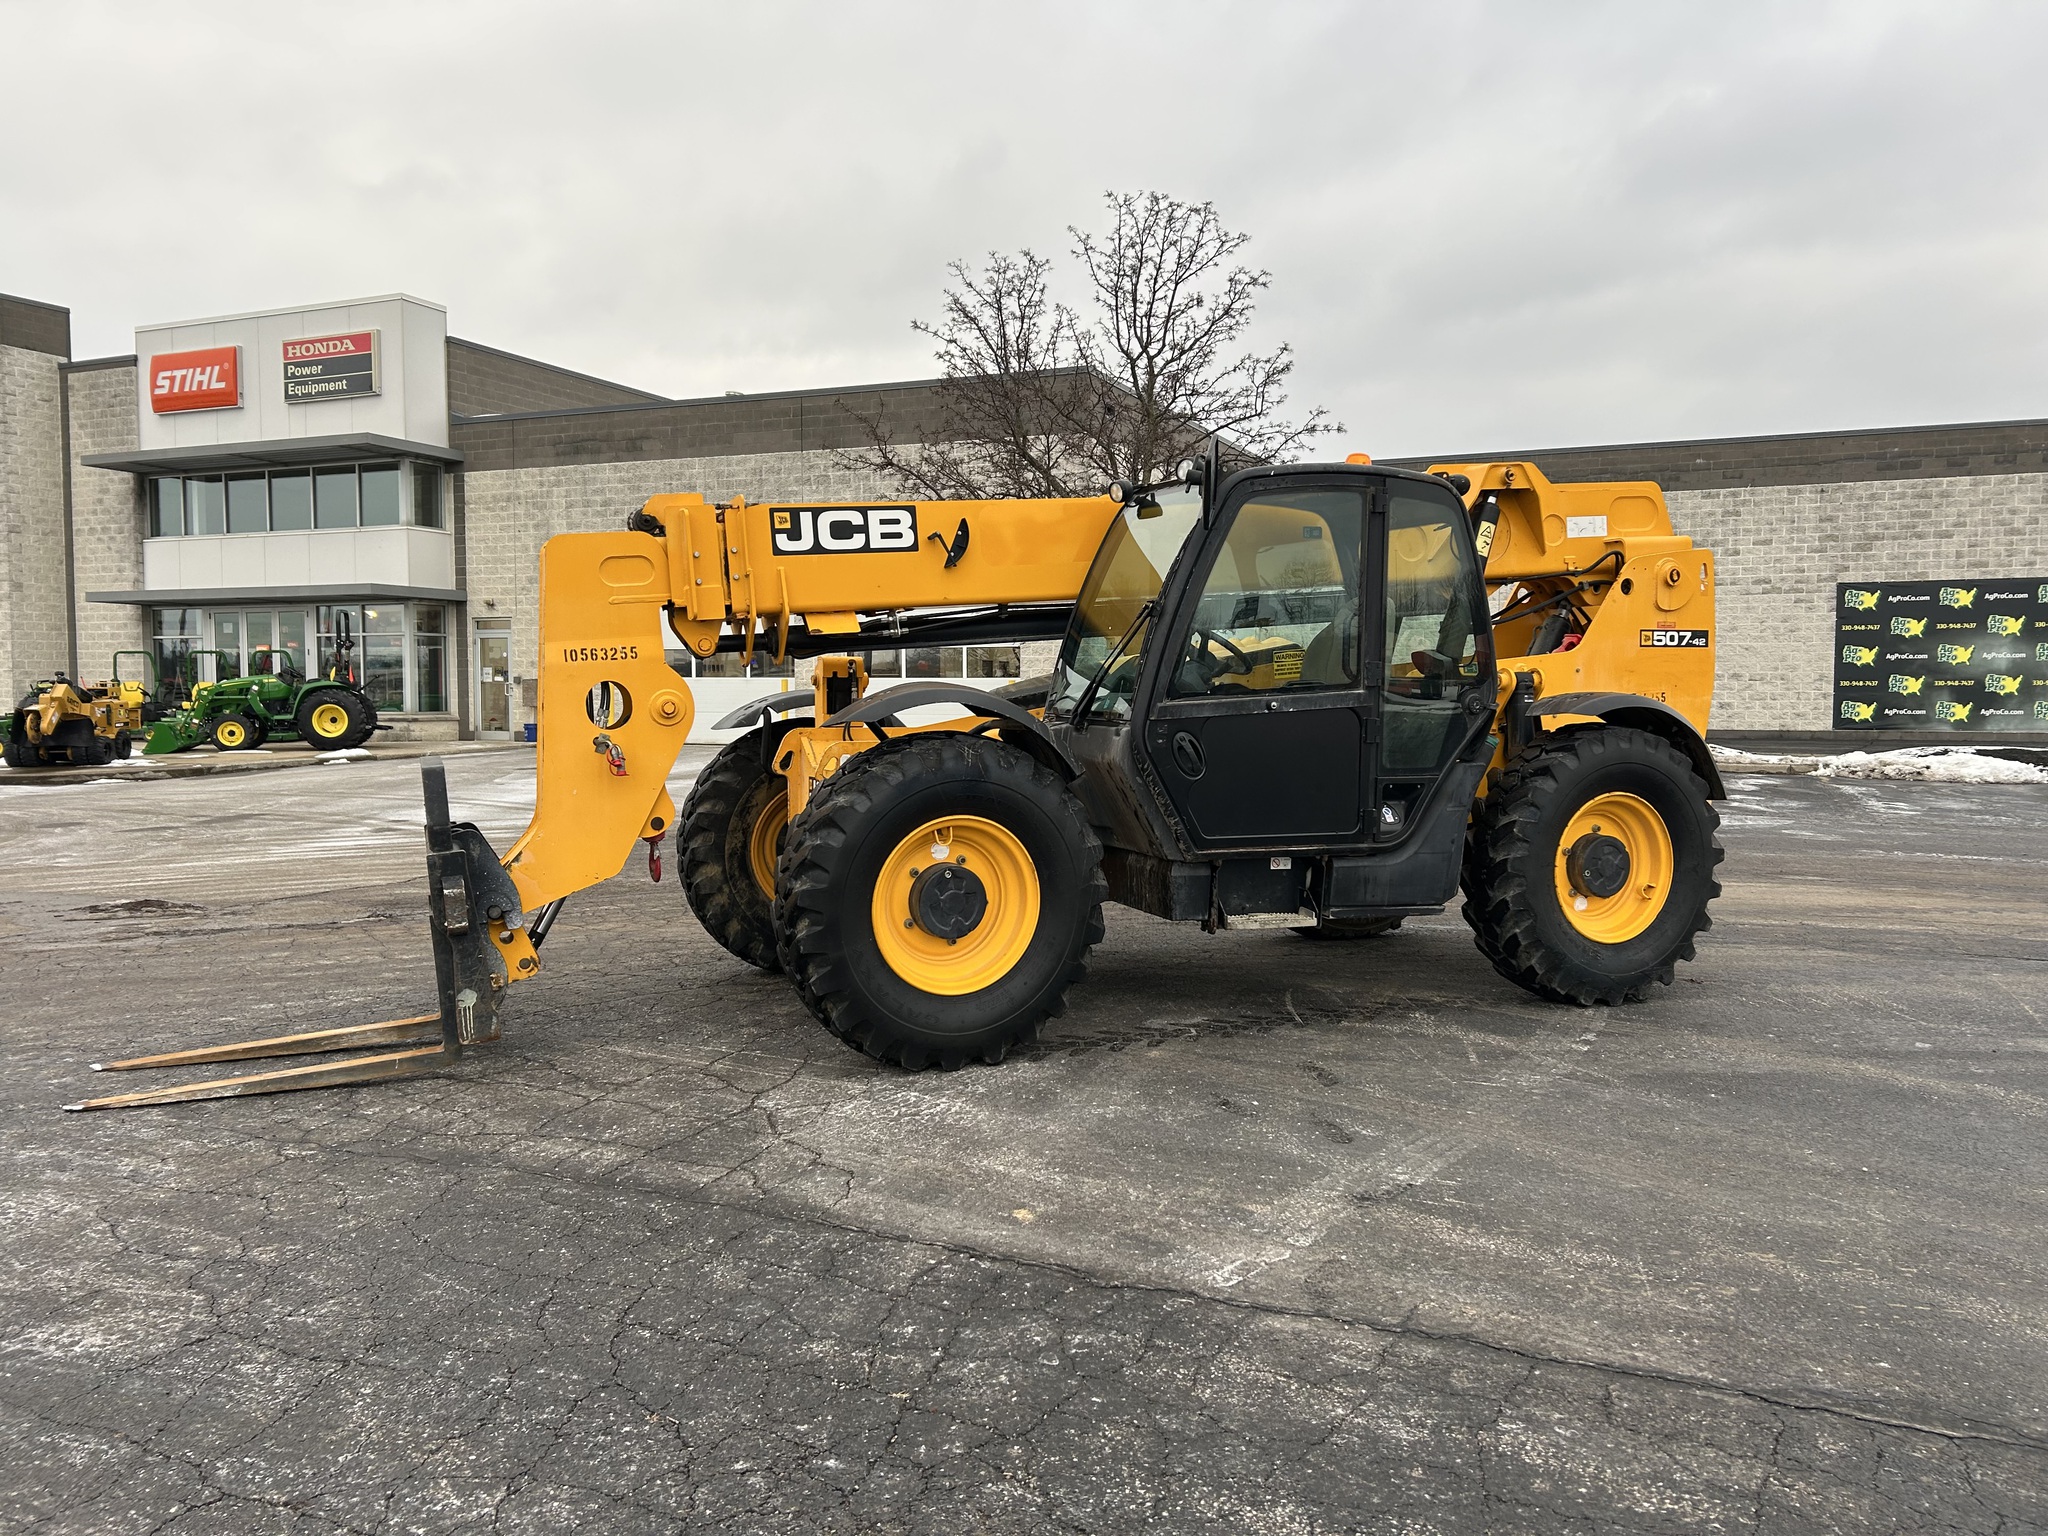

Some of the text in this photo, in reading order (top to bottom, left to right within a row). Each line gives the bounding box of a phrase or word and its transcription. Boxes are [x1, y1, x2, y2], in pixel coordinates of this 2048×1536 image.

[287, 339, 355, 357] HONDA
[287, 365, 322, 377] Power
[153, 365, 226, 394] STIHL
[288, 379, 347, 396] Equipment
[775, 509, 915, 551] JCB
[1846, 599, 1864, 607] Pro
[1888, 595, 1930, 603] AgProCo.com
[1941, 596, 1959, 605] Pro
[1892, 626, 1910, 634] Pro
[1989, 624, 2008, 632] Pro
[563, 646, 638, 662] 10563255
[1844, 654, 1862, 662] Pro
[1886, 653, 1928, 661] AgProCo.com
[1939, 653, 1957, 661] Pro
[1982, 652, 2026, 660] AgProCo.com
[1890, 683, 1908, 691] Pro
[1987, 683, 2006, 691] Pro
[1842, 710, 1860, 718] Pro
[1884, 708, 1926, 716] AgProCo.com
[1937, 709, 1956, 718] Pro
[1980, 708, 2024, 716] AgProCo.com
